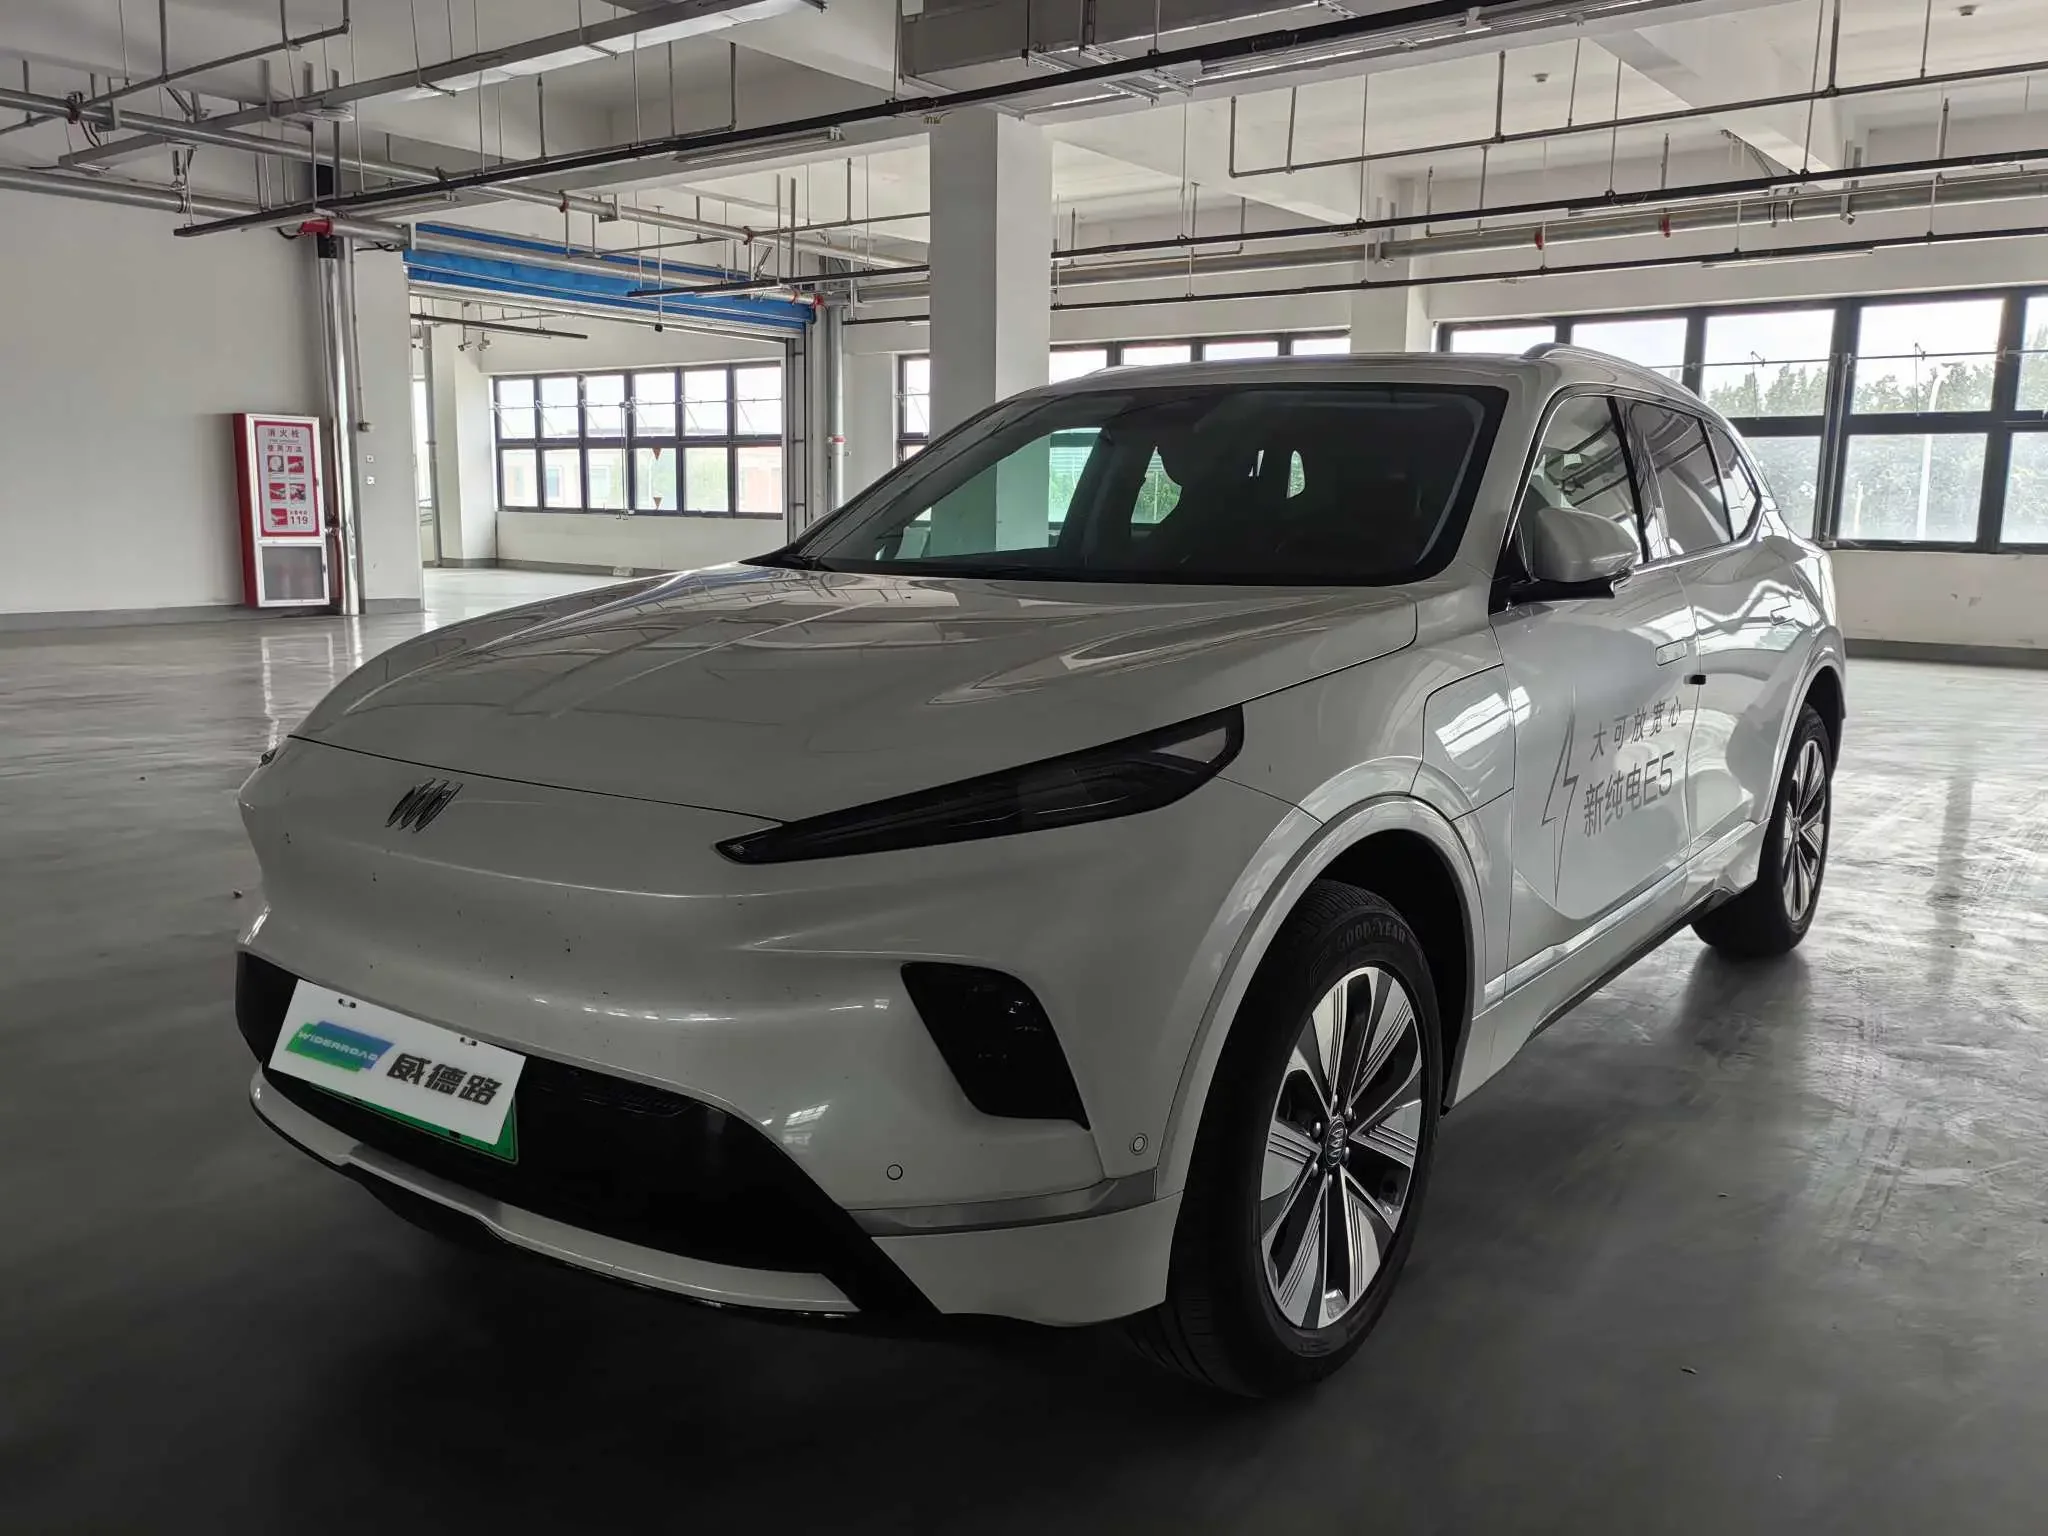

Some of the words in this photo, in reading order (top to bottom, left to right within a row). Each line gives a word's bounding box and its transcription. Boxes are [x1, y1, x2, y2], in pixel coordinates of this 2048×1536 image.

[290, 515, 308, 525] 119
[1589, 695, 1682, 762] 大可放宽心
[1584, 751, 1675, 837] 新纯电E5
[298, 1031, 379, 1061] WIDERROAD
[387, 1053, 503, 1106] 威德路
